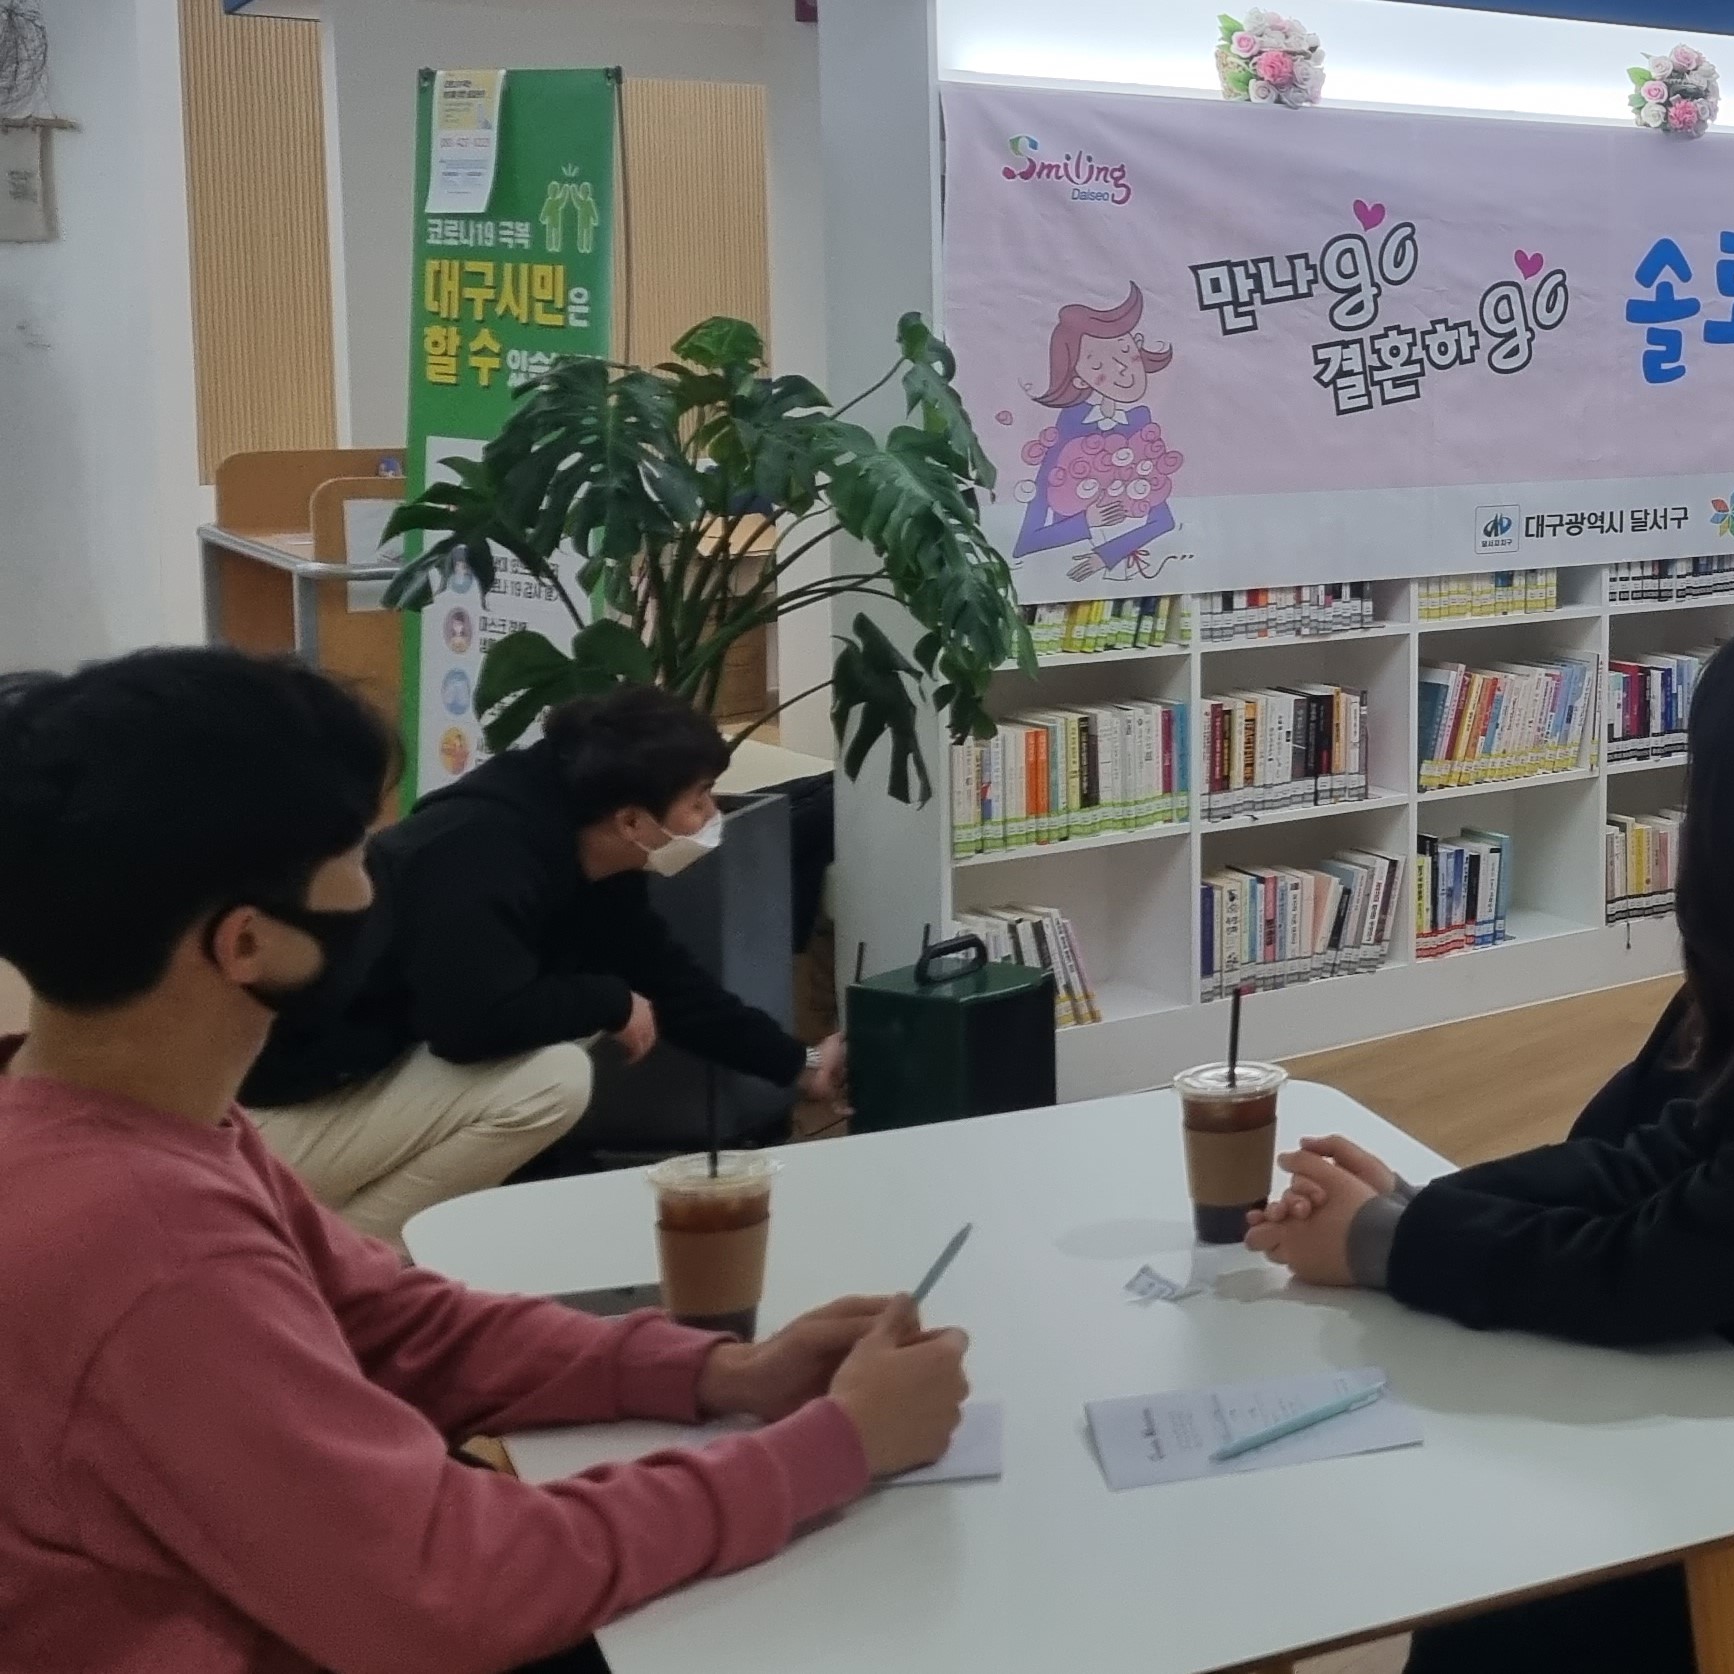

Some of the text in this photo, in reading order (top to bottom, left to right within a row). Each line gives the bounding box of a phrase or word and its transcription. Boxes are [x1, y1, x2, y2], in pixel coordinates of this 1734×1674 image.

[1002, 135, 1131, 205] Smiling
[426, 218, 531, 249] 코로나19 극복
[424, 258, 590, 328] 대구시민은
[1189, 222, 1419, 336] 만나go
[424, 326, 461, 386] 할
[468, 328, 501, 388] 수
[1312, 269, 1569, 416] 결혼하go
[1524, 506, 1690, 540] 대구광역시 달서구
